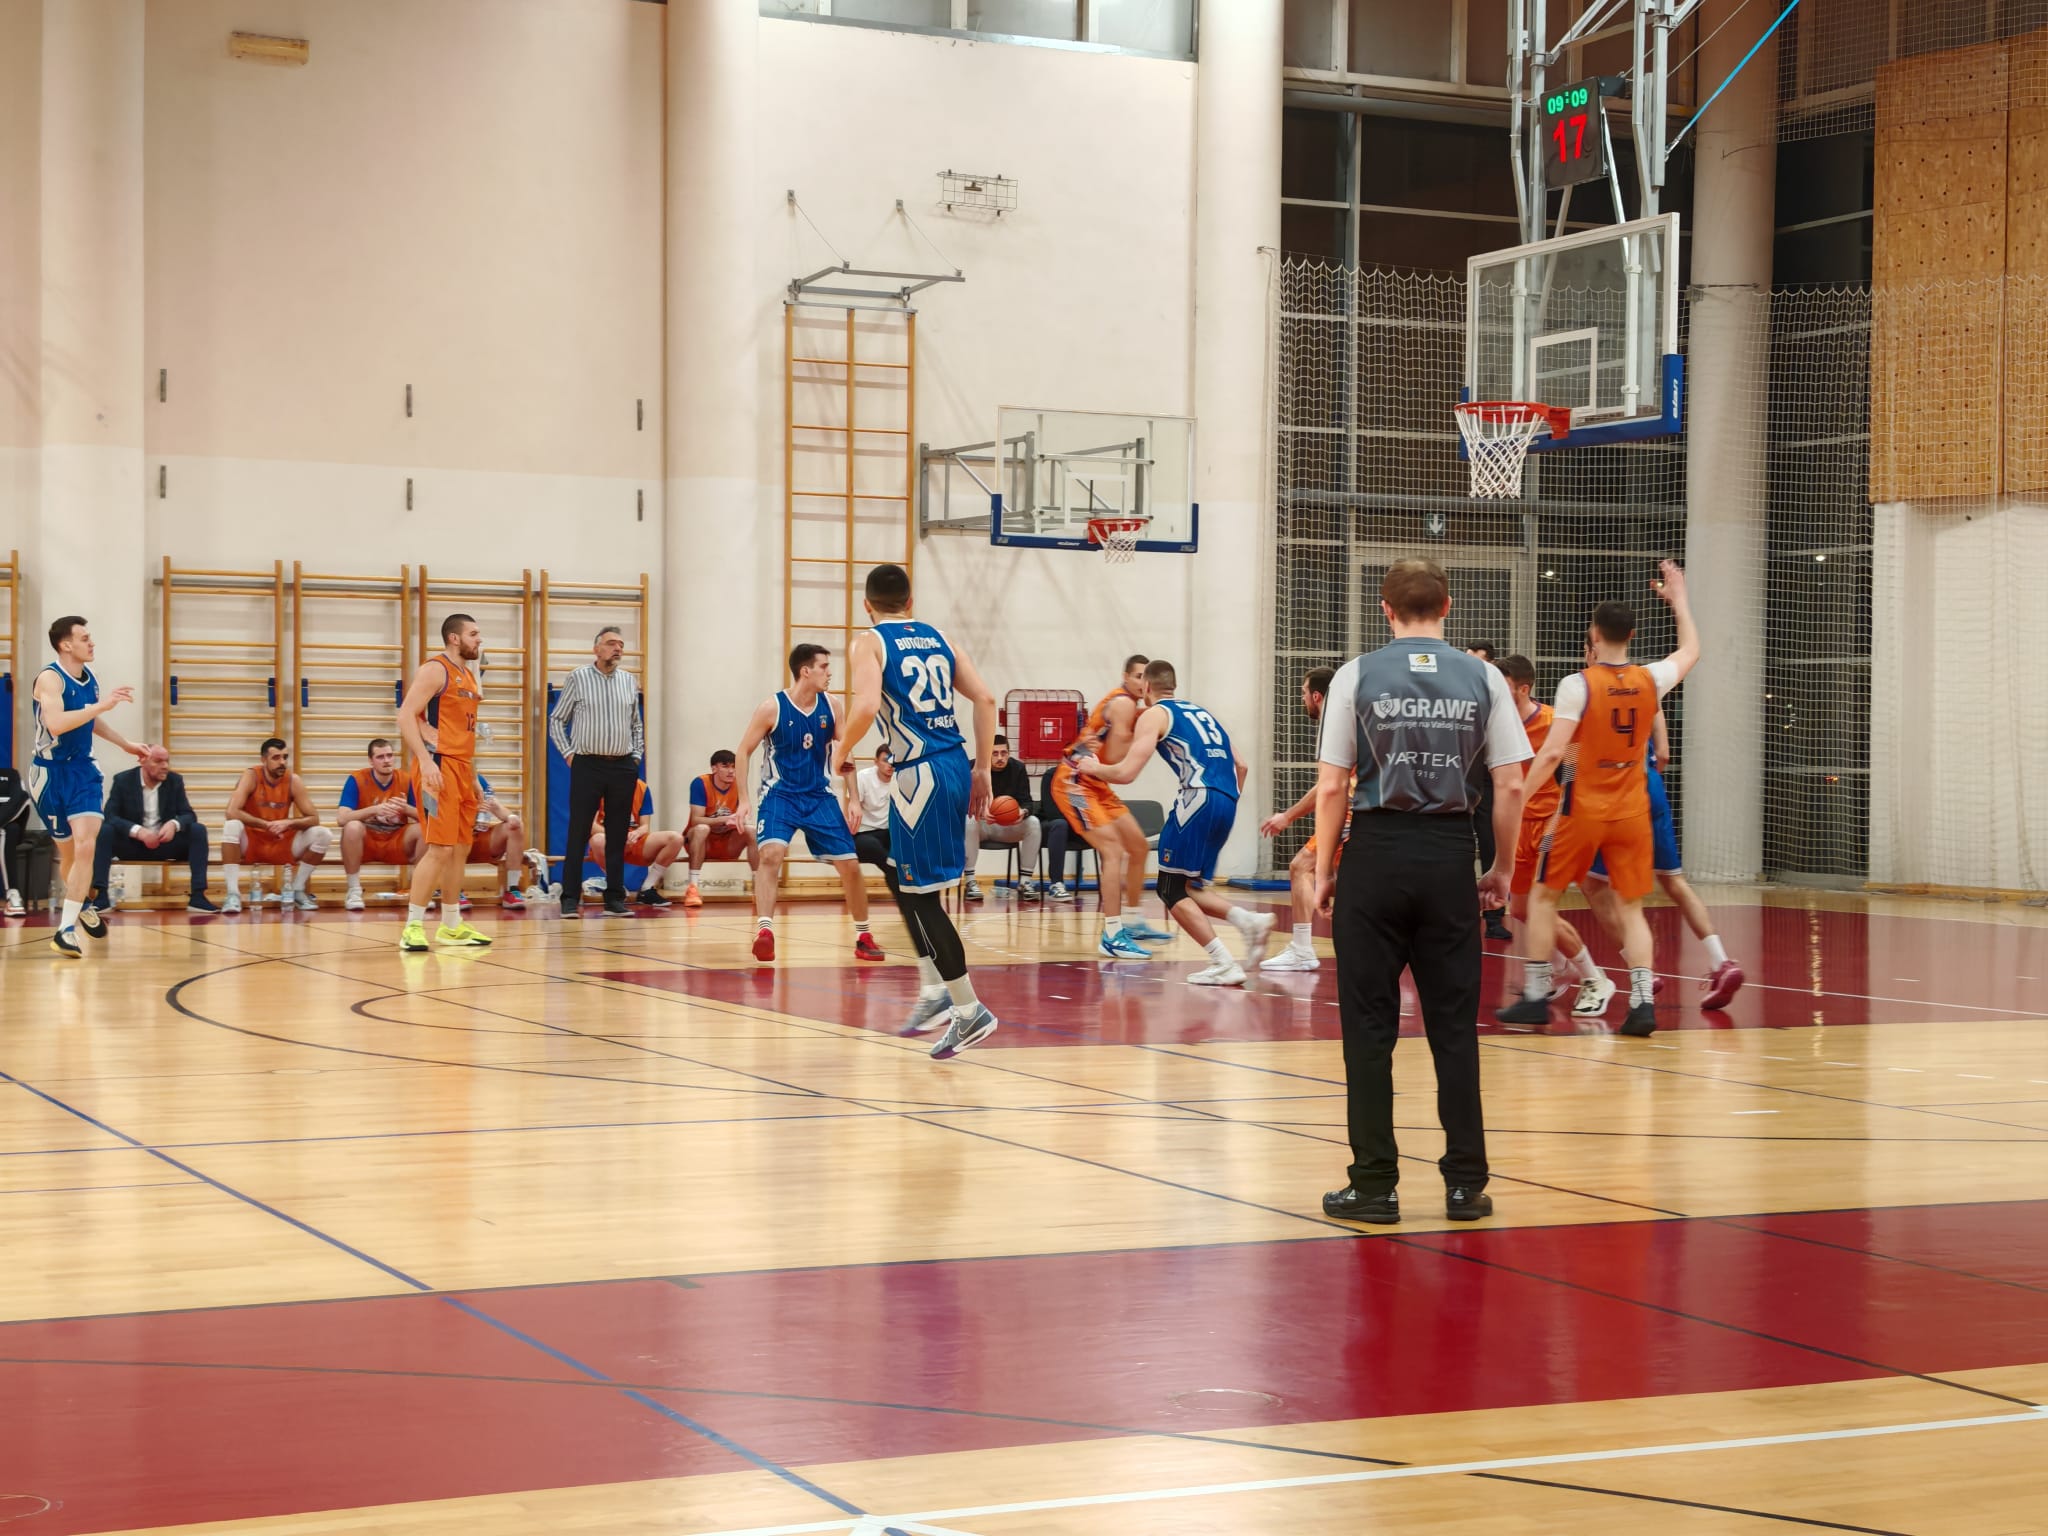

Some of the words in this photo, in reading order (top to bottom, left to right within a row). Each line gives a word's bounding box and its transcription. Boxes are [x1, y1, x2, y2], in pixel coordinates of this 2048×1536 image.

[1548, 88, 1588, 114] 09:09
[1553, 114, 1587, 163] 17
[901, 655, 953, 713] 20
[1401, 698, 1478, 721] GRAWE
[803, 733, 813, 749] 8
[1182, 711, 1223, 745] 13
[1611, 707, 1636, 748] 4
